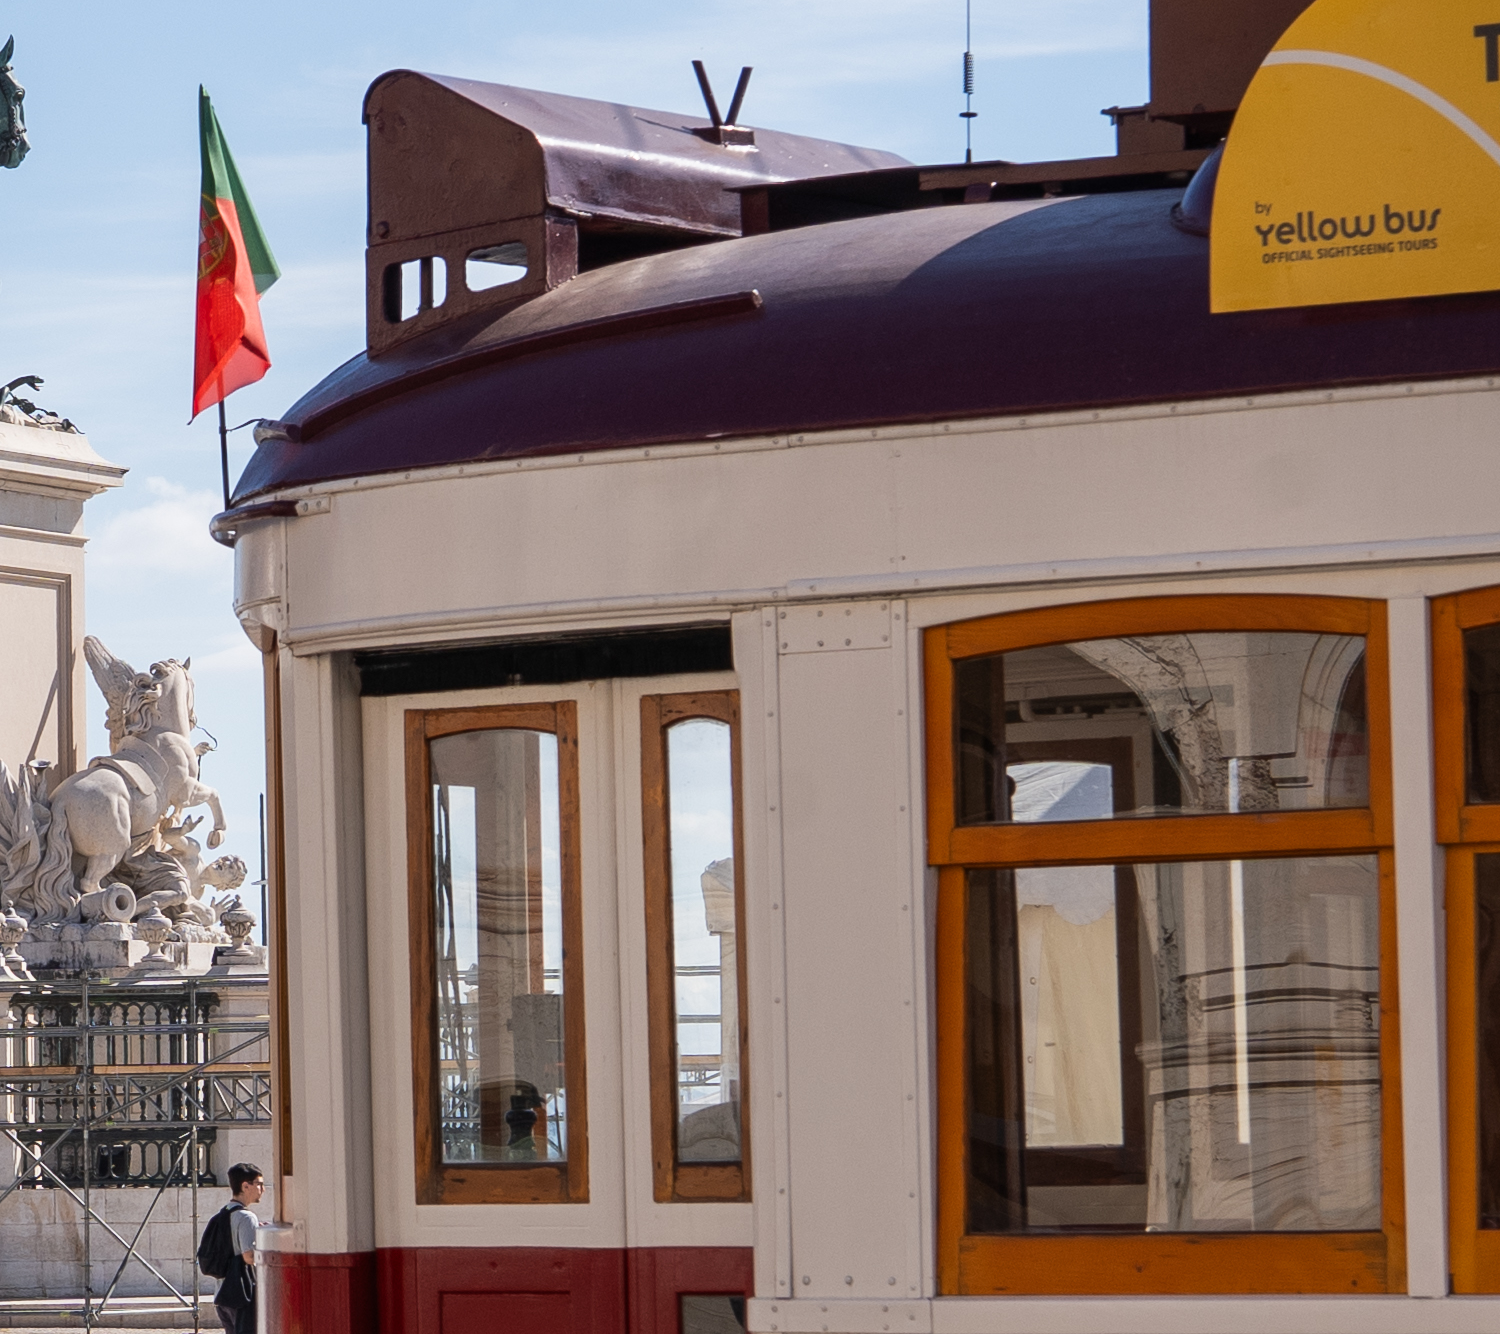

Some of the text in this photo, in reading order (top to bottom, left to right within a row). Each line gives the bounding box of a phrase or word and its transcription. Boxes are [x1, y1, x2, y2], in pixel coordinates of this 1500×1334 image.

[1255, 201, 1272, 216] by
[1383, 204, 1441, 234] bus
[1262, 238, 1438, 265] OFFICIAL SIGHTSEEING TOURS
